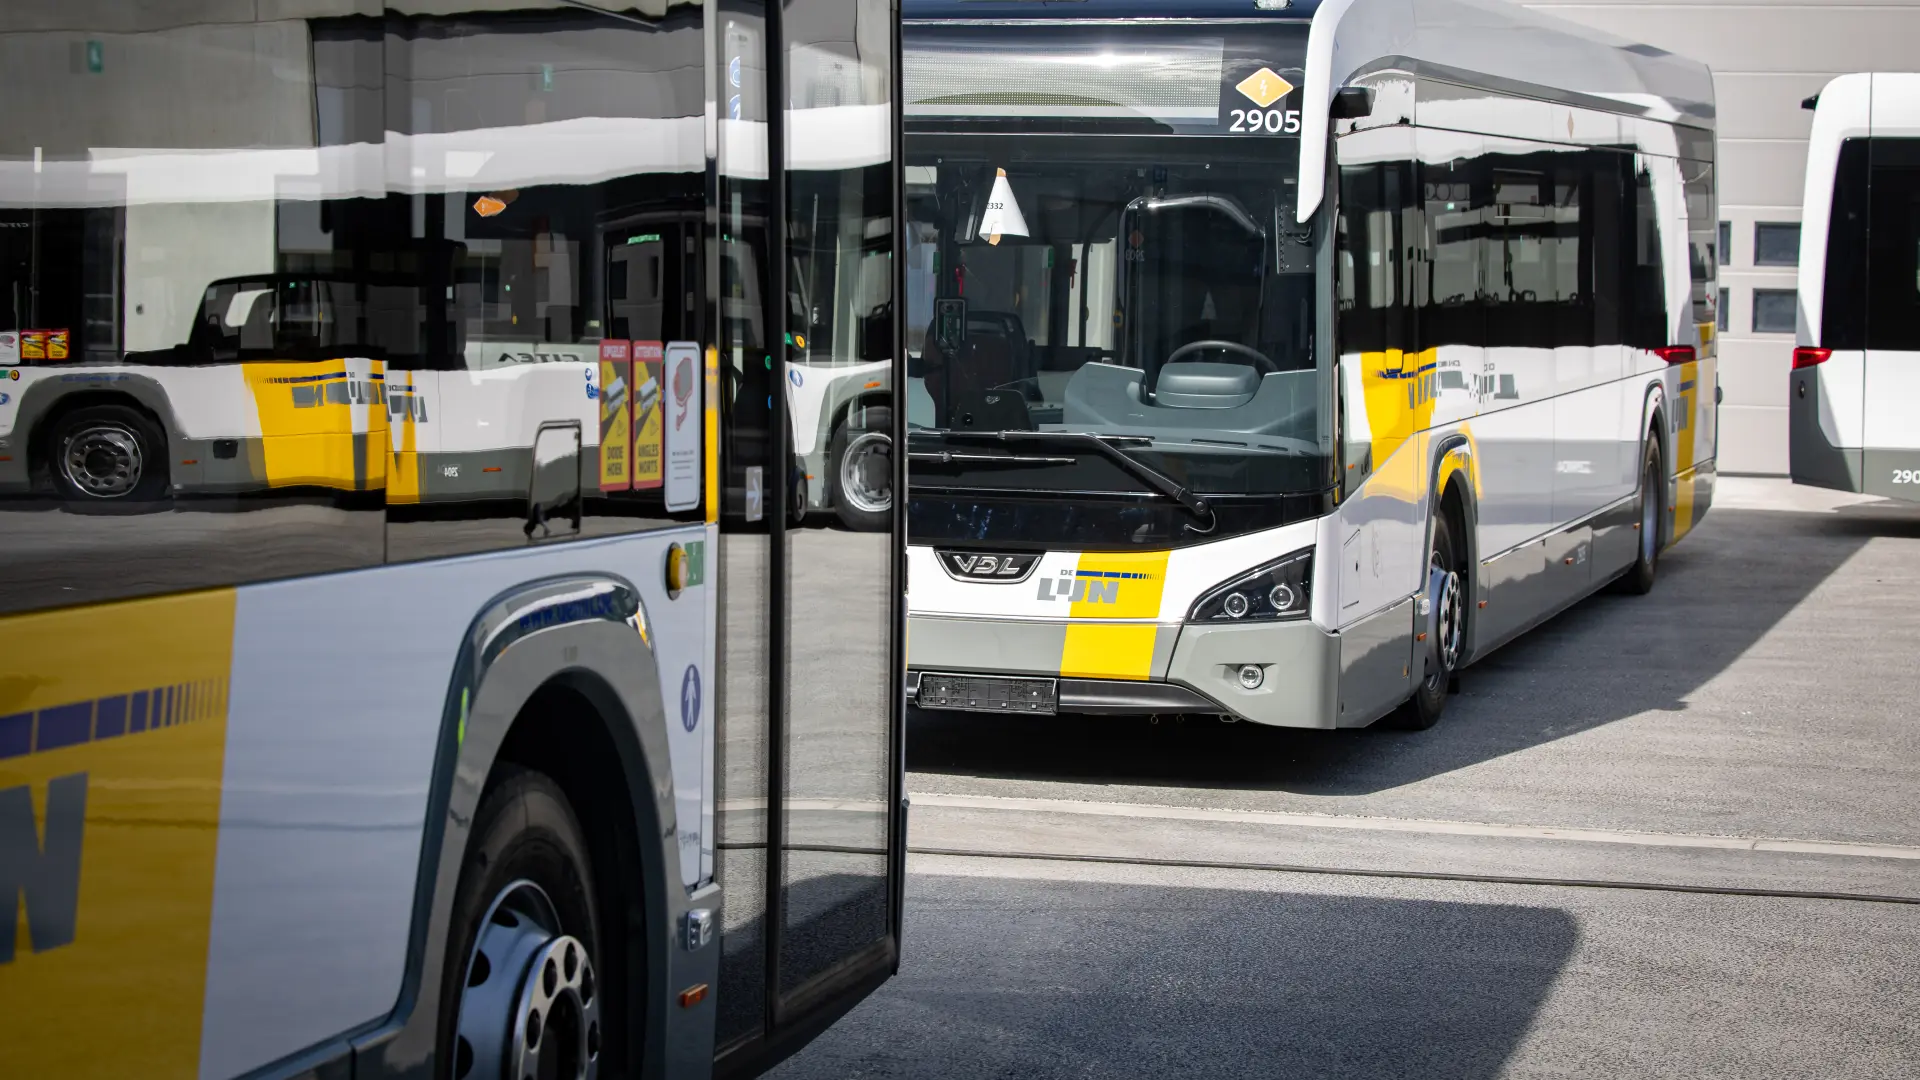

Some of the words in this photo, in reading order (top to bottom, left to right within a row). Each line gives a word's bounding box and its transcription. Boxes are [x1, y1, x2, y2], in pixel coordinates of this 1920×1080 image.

[1229, 109, 1300, 133] 2905
[607, 446, 623, 459] DODE
[638, 444, 659, 457] ANGLES
[607, 462, 623, 476] HOEK
[638, 459, 658, 474] MORTS
[953, 555, 1020, 575] VDL
[1037, 577, 1119, 604] LIJN
